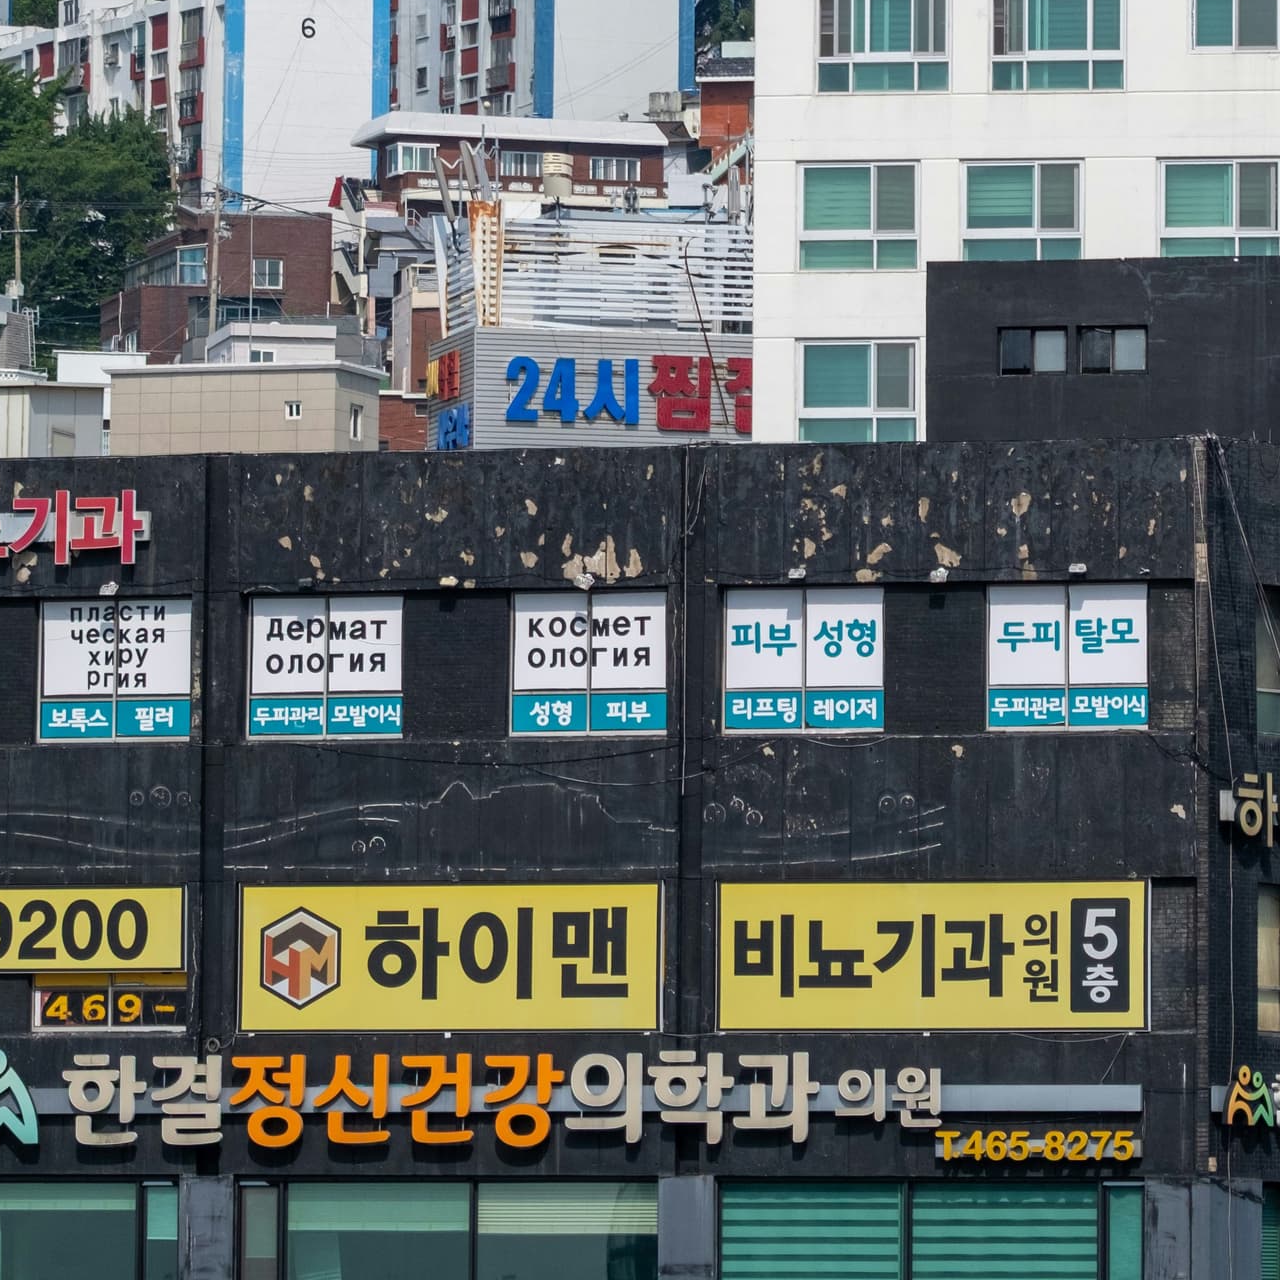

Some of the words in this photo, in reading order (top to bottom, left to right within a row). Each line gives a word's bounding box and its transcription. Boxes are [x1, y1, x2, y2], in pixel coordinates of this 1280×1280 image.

[301, 17, 316, 40] 6
[505, 355, 640, 426] 24시
[69, 603, 167, 624] пласти
[527, 614, 652, 638] космет
[70, 627, 167, 646] ческая
[731, 620, 798, 658] 피부
[813, 618, 878, 659] 성형
[996, 619, 1061, 654] 두피
[1074, 617, 1140, 655] 탈모
[88, 647, 148, 669] хиру
[265, 650, 387, 675] ология
[526, 645, 652, 669] ология
[86, 669, 148, 691] ргия
[47, 708, 109, 734] 보톡스
[133, 705, 174, 732] 필러
[252, 705, 324, 730] 두피관리
[330, 703, 402, 728] 모발이식
[529, 699, 573, 727] 성형
[605, 699, 652, 724] 피부
[731, 696, 798, 724] 리프팅
[813, 696, 877, 722] 레이저
[990, 696, 1066, 721] 두피관리
[1071, 693, 1147, 719] 모발이식
[364, 906, 629, 1001] 하이맨
[733, 912, 1016, 999] 비뇨기과
[1081, 907, 1120, 1004] 5층
[834, 1066, 943, 1130] 의원
[934, 1129, 1135, 1163] T.465-8275
